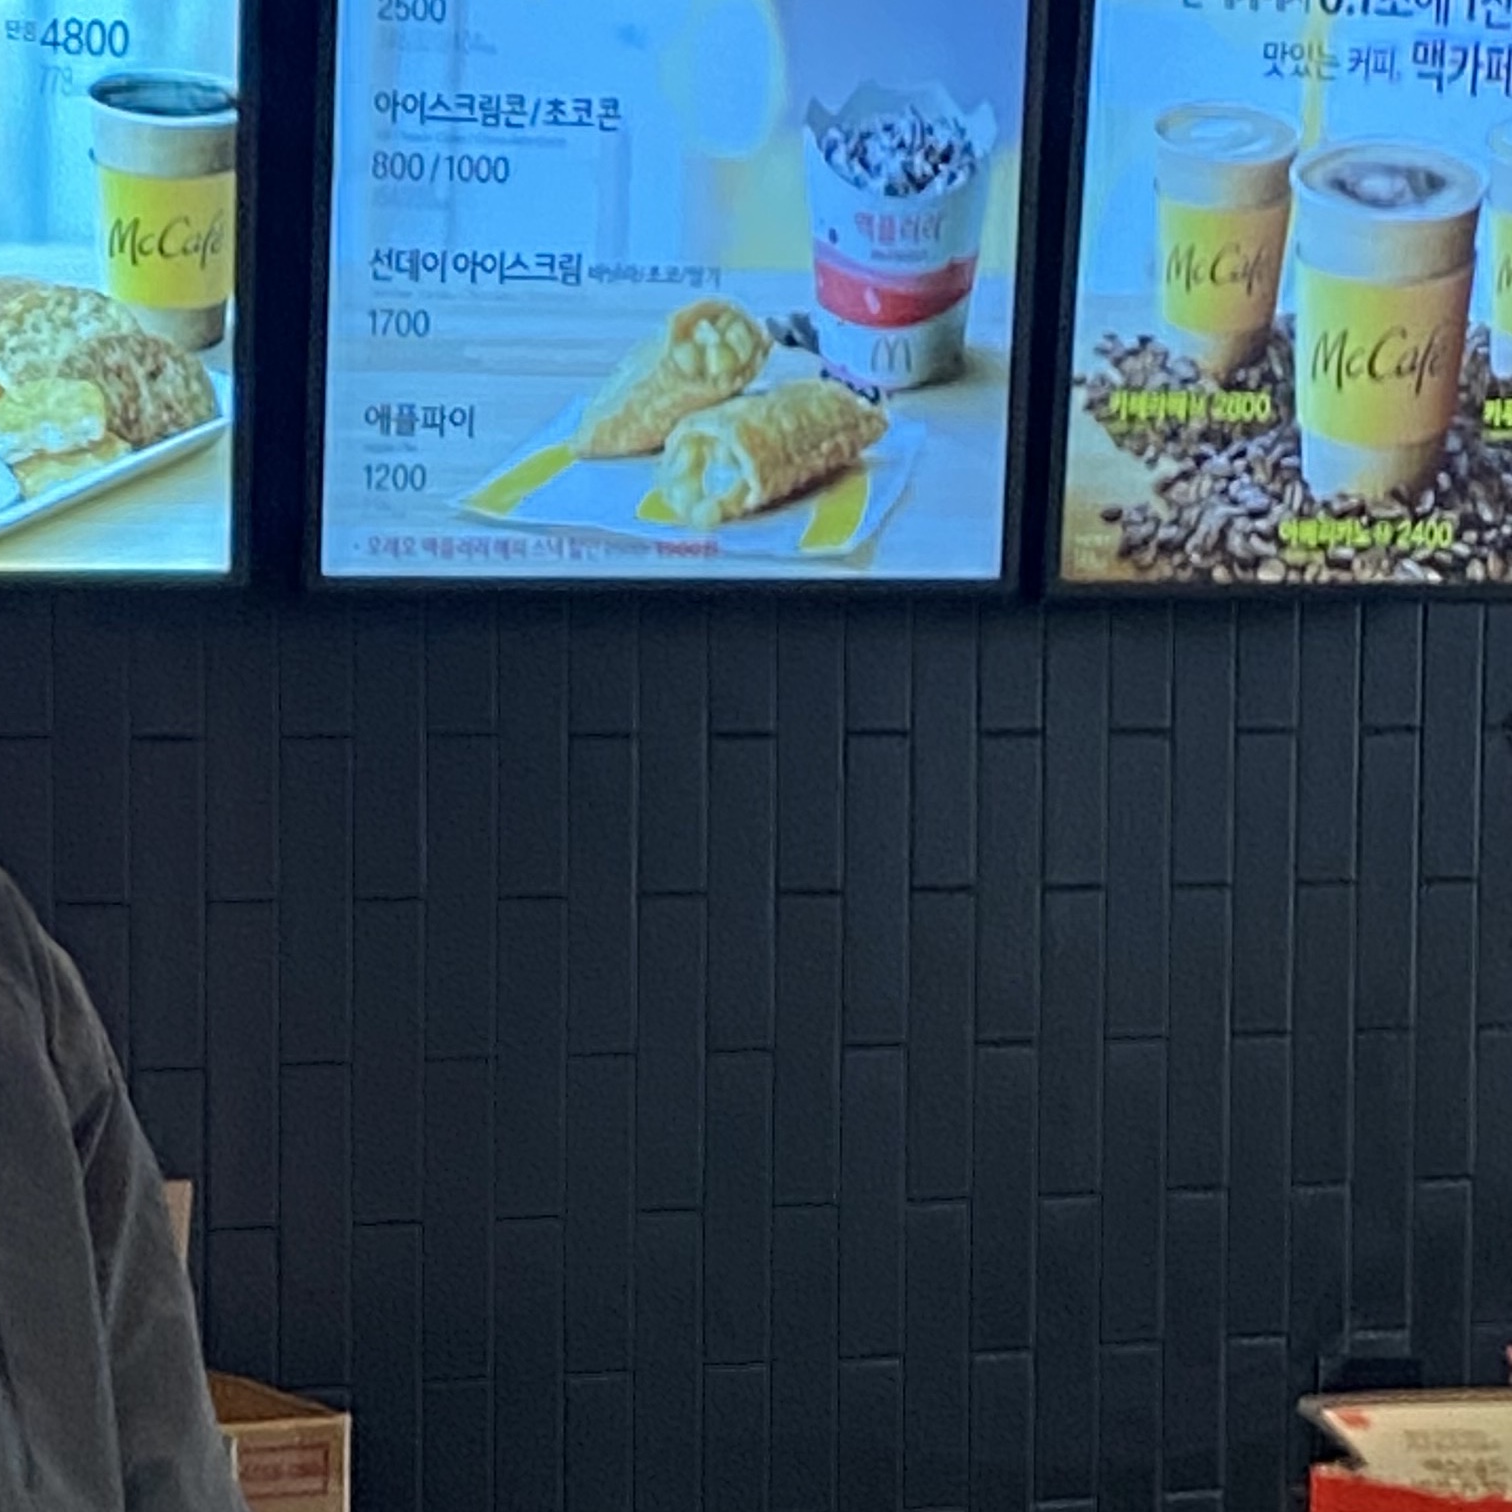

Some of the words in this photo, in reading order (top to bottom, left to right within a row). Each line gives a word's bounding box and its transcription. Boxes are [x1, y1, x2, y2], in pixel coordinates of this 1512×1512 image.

[376, 0, 447, 24] 2500
[40, 17, 130, 58] 4800
[1262, 41, 1340, 81] 맛있는
[1347, 44, 1403, 84] 커피,
[368, 248, 446, 283] 선데이
[452, 250, 582, 287] 아이스크림
[367, 309, 431, 338] 1700
[363, 462, 427, 492] 1200
